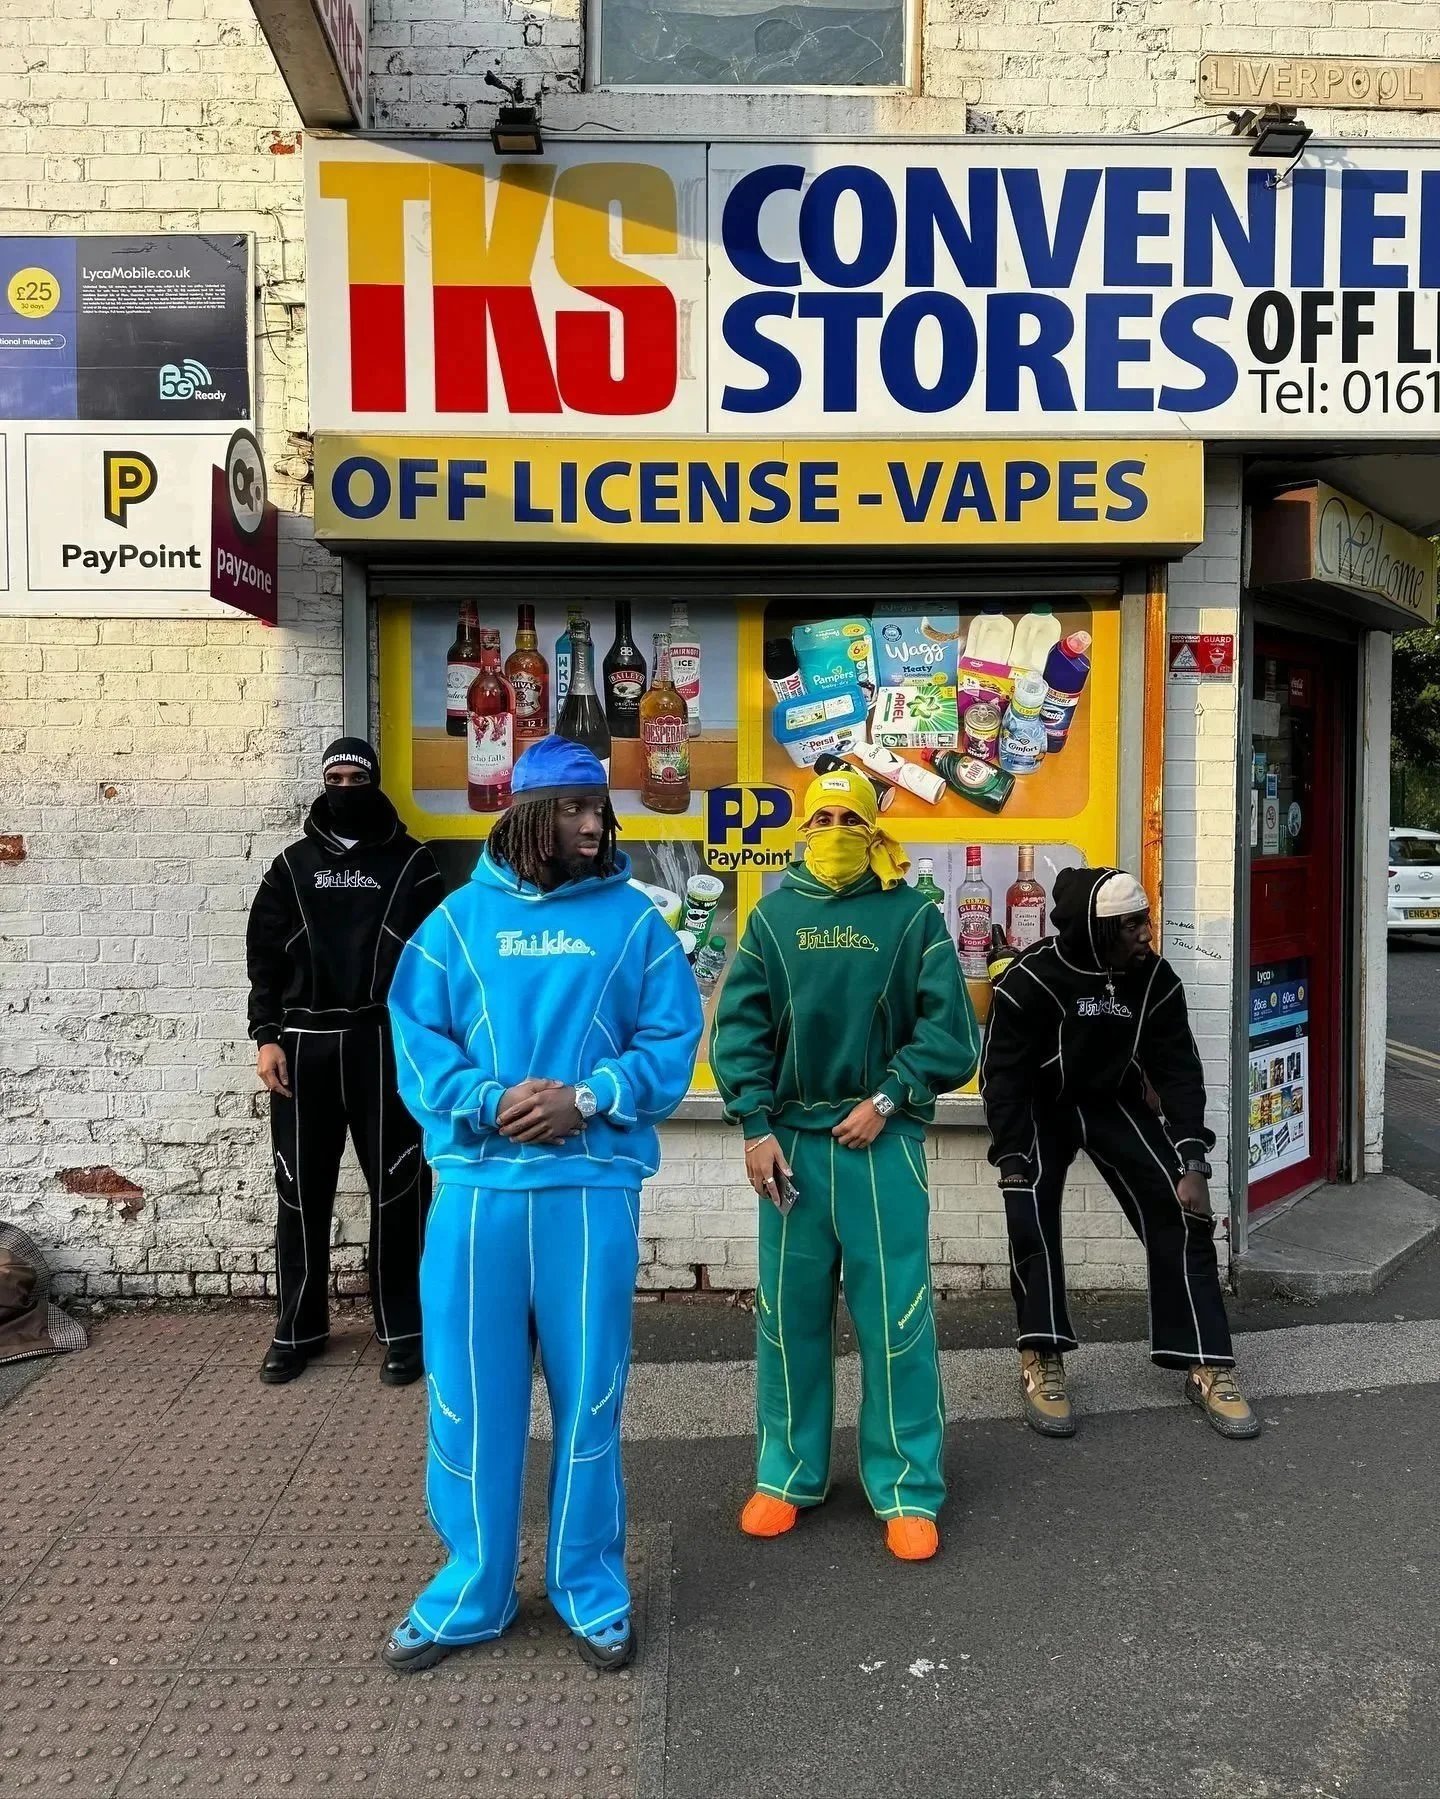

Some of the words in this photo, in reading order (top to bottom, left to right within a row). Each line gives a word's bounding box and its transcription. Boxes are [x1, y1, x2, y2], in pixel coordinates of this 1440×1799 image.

[1210, 58, 1424, 101] LIVERPOOL
[722, 165, 1440, 289] CONVENIE
[83, 266, 191, 282] LycaMobile.co.uk
[16, 281, 52, 302] £25
[319, 161, 679, 416] TKS
[1246, 290, 1376, 364] OFF
[1397, 290, 1440, 364] L
[722, 290, 1239, 414] STORES
[161, 371, 193, 398] 5G
[195, 390, 226, 401] Ready
[1248, 366, 1329, 414] Tel:
[1342, 369, 1440, 414] 0161
[331, 459, 482, 520] OFF
[514, 464, 836, 522] LICENSE
[62, 544, 202, 574] PayPoint
[1319, 496, 1425, 609] Welcome
[217, 547, 272, 594] payzone
[885, 641, 949, 665] Wagg
[609, 672, 645, 684] BAILEYS
[813, 670, 854, 686] Pampers
[902, 665, 933, 673] Meaty
[511, 681, 537, 690] HIVAS
[891, 692, 906, 723] ARIEL
[527, 720, 536, 728] 12
[809, 736, 835, 750] Persil
[1008, 742, 1038, 753] Comfort
[487, 753, 506, 762] falls
[965, 759, 983, 781] FAIRY
[707, 848, 792, 870] PayPoint
[959, 904, 991, 913] GLEN'S
[1408, 909, 1429, 918] EN64
[1172, 937, 1194, 950] Jaw
[1256, 970, 1271, 984] Lyca
